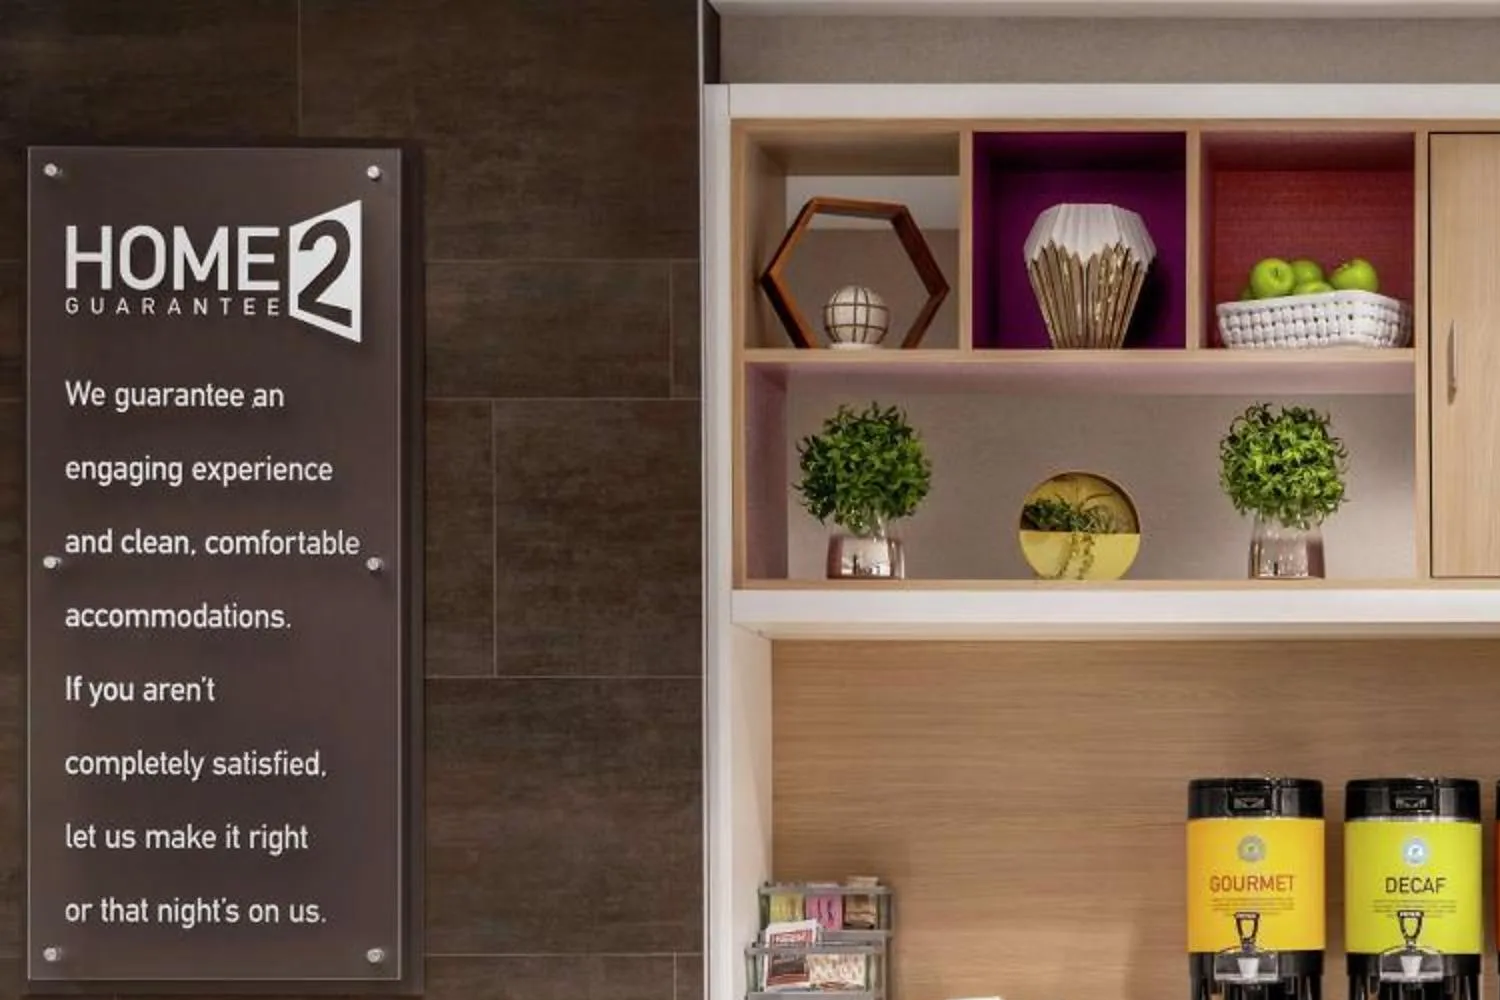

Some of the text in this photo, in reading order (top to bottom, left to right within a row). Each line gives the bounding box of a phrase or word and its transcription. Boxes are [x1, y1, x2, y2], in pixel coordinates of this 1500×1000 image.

[66, 297, 279, 315] GUARANTEE
[65, 381, 284, 412] We guarantee an
[66, 455, 333, 487] engaging experience
[65, 528, 112, 553] and
[205, 529, 360, 555] comfortable
[65, 602, 291, 628] accommodations.
[66, 675, 215, 707] If you aren't
[65, 750, 204, 781] completely
[66, 823, 308, 856] let us make it right
[1209, 874, 1295, 893] GOURMET
[1385, 876, 1447, 894] DECAF
[65, 897, 326, 929] or that night's on us.
